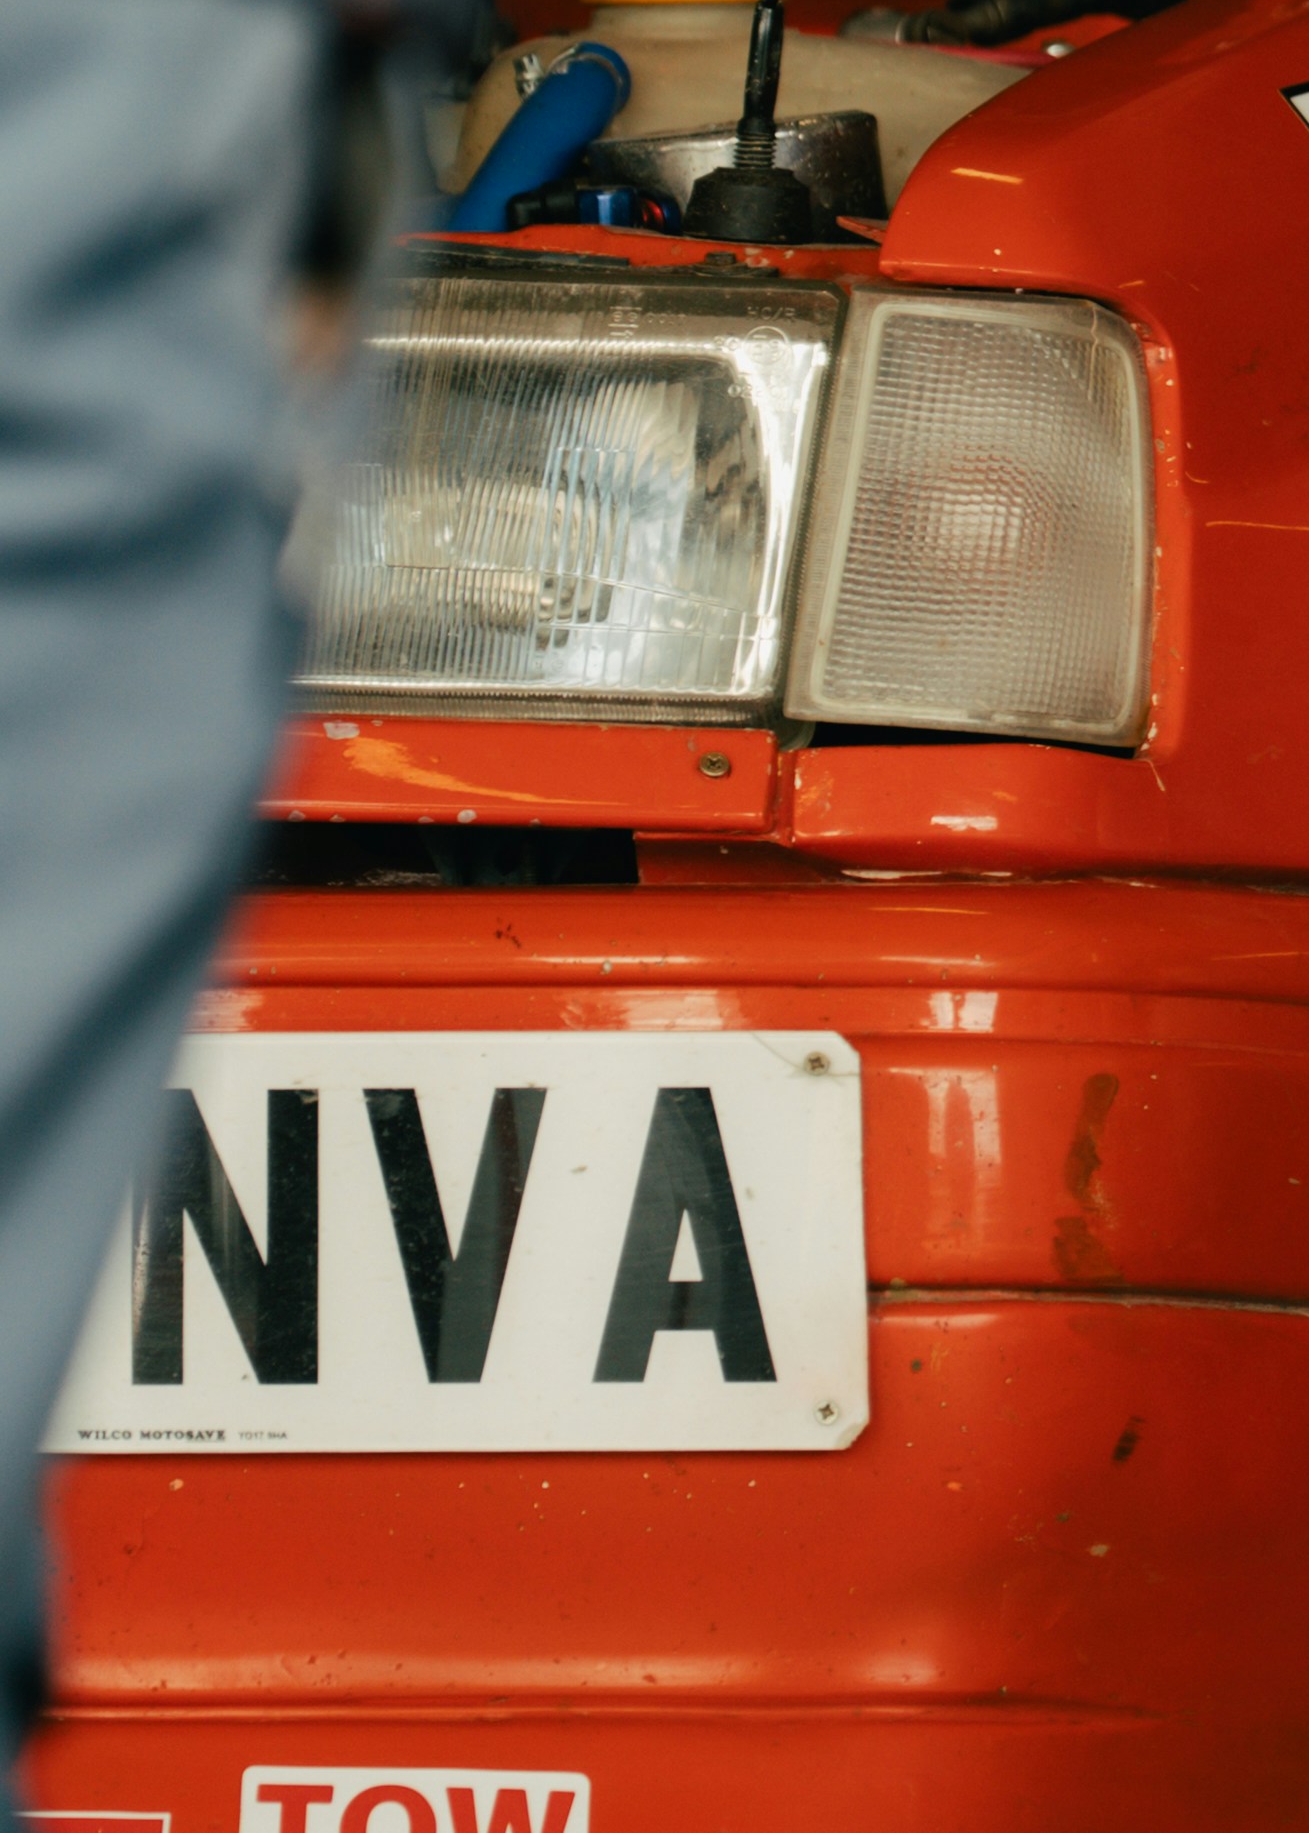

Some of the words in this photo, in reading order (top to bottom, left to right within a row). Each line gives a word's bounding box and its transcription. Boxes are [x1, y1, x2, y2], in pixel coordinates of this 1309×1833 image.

[130, 1086, 779, 1386] NVA
[78, 1429, 132, 1441] WILCO
[140, 1429, 226, 1442] MOTOSAVE
